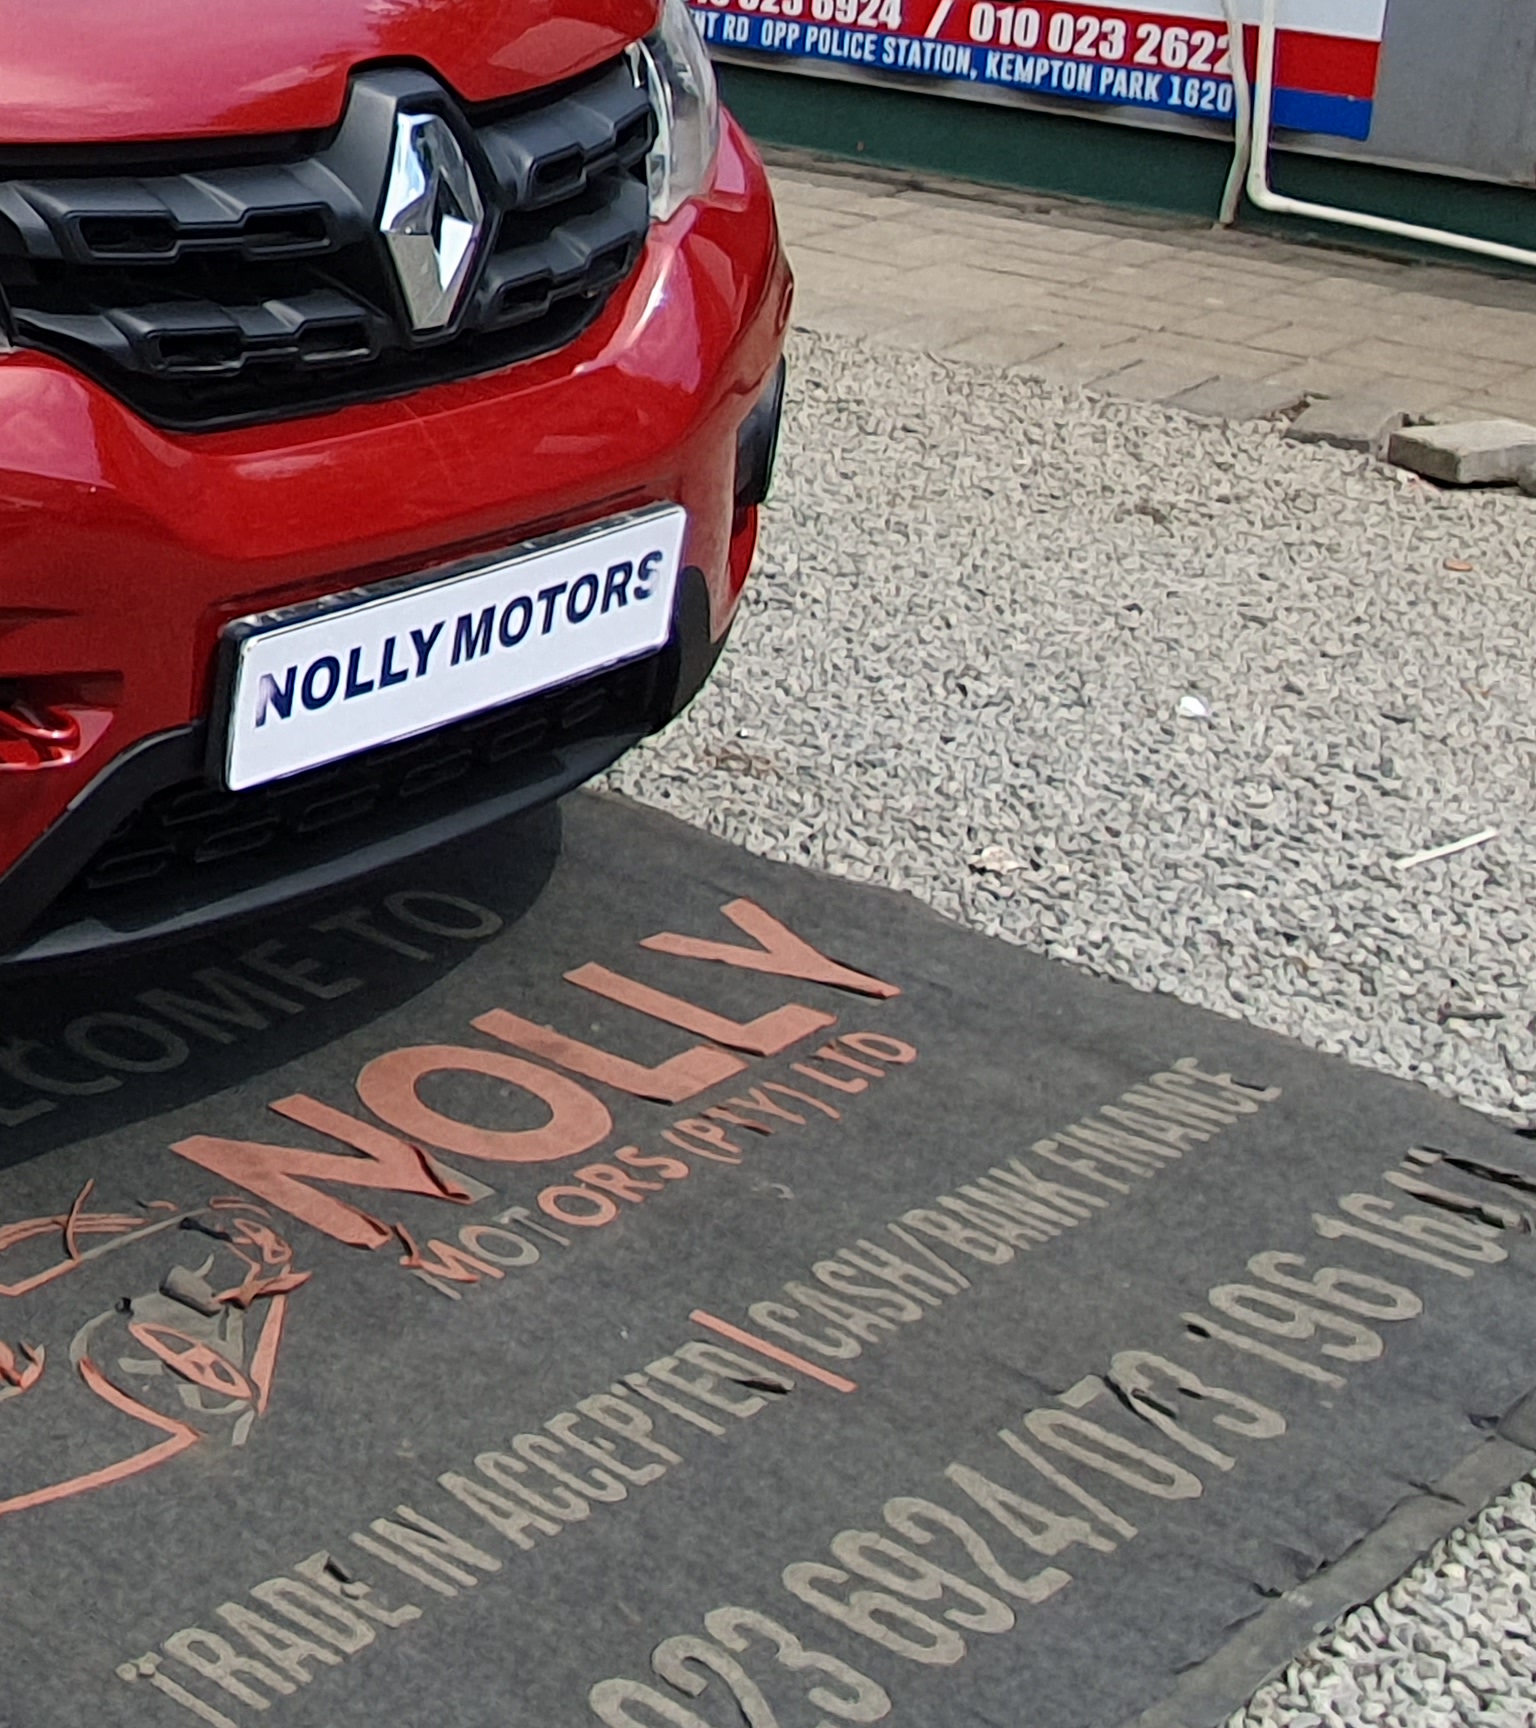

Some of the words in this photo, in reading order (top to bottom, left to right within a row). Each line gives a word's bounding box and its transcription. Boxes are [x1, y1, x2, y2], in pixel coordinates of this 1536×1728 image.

[690, 8, 720, 40] NT
[722, 13, 750, 43] RD
[760, 17, 800, 50] OPP
[804, 24, 877, 62] POLICE
[882, 35, 977, 80] STATION,
[985, 50, 1093, 94] KEMPTON
[1099, 66, 1162, 103] PARK
[1167, 78, 1234, 113] 1620
[969, 1, 1041, 49] 010
[1047, 12, 1127, 60] 023
[1133, 22, 1233, 74] 2622
[254, 619, 447, 729] NOLLY
[450, 548, 664, 668] MOTORS
[311, 889, 505, 962] TO
[168, 896, 904, 1251] NOLLY
[398, 1144, 691, 1302] MOTORS
[115, 1549, 424, 1728] TRADE
[348, 1503, 503, 1598] IN
[436, 1338, 796, 1551] ACCEPTED
[746, 1156, 1111, 1361] CASH/BANK
[1030, 1056, 1283, 1195] FINANCE
[783, 1350, 1287, 1666] 6924/073
[1179, 1249, 1424, 1388] 196
